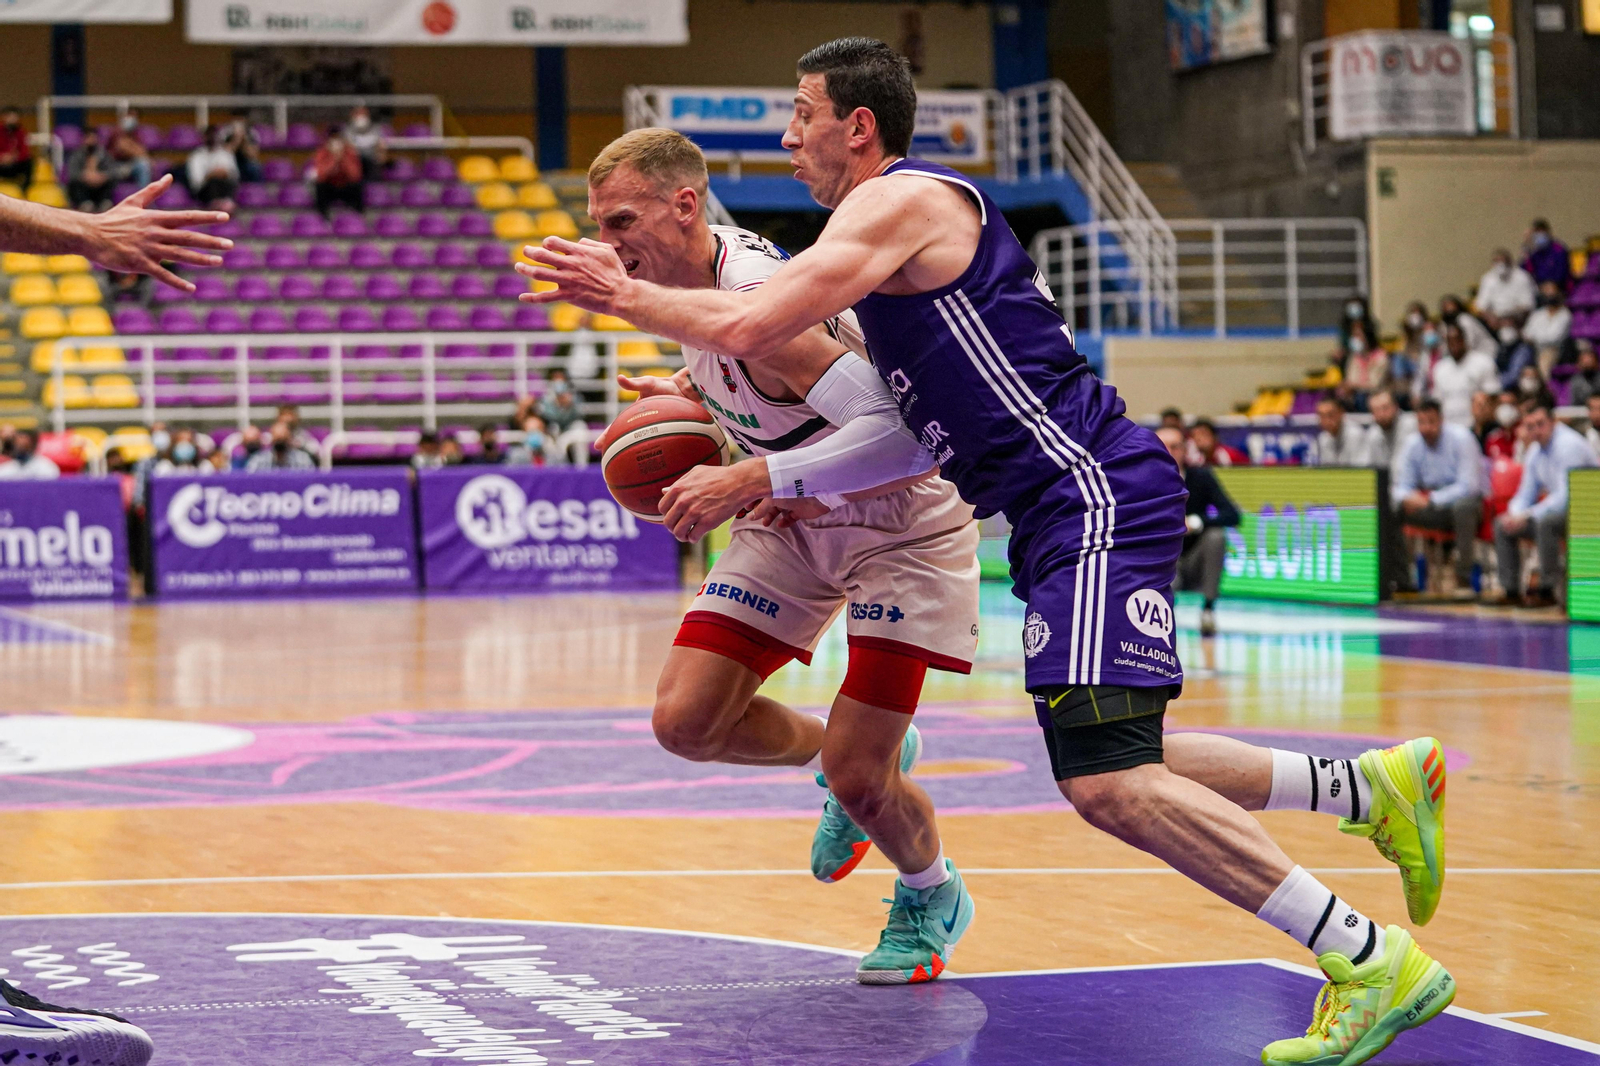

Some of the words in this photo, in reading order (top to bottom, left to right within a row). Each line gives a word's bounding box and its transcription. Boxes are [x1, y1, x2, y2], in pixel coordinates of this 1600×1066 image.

[489, 543, 618, 570] ventanas
[706, 583, 780, 618] BERNER
[1135, 598, 1168, 632] VA!
[1114, 657, 1136, 667] ciudad
[1136, 661, 1155, 672] amiga
[1156, 666, 1164, 675] del
